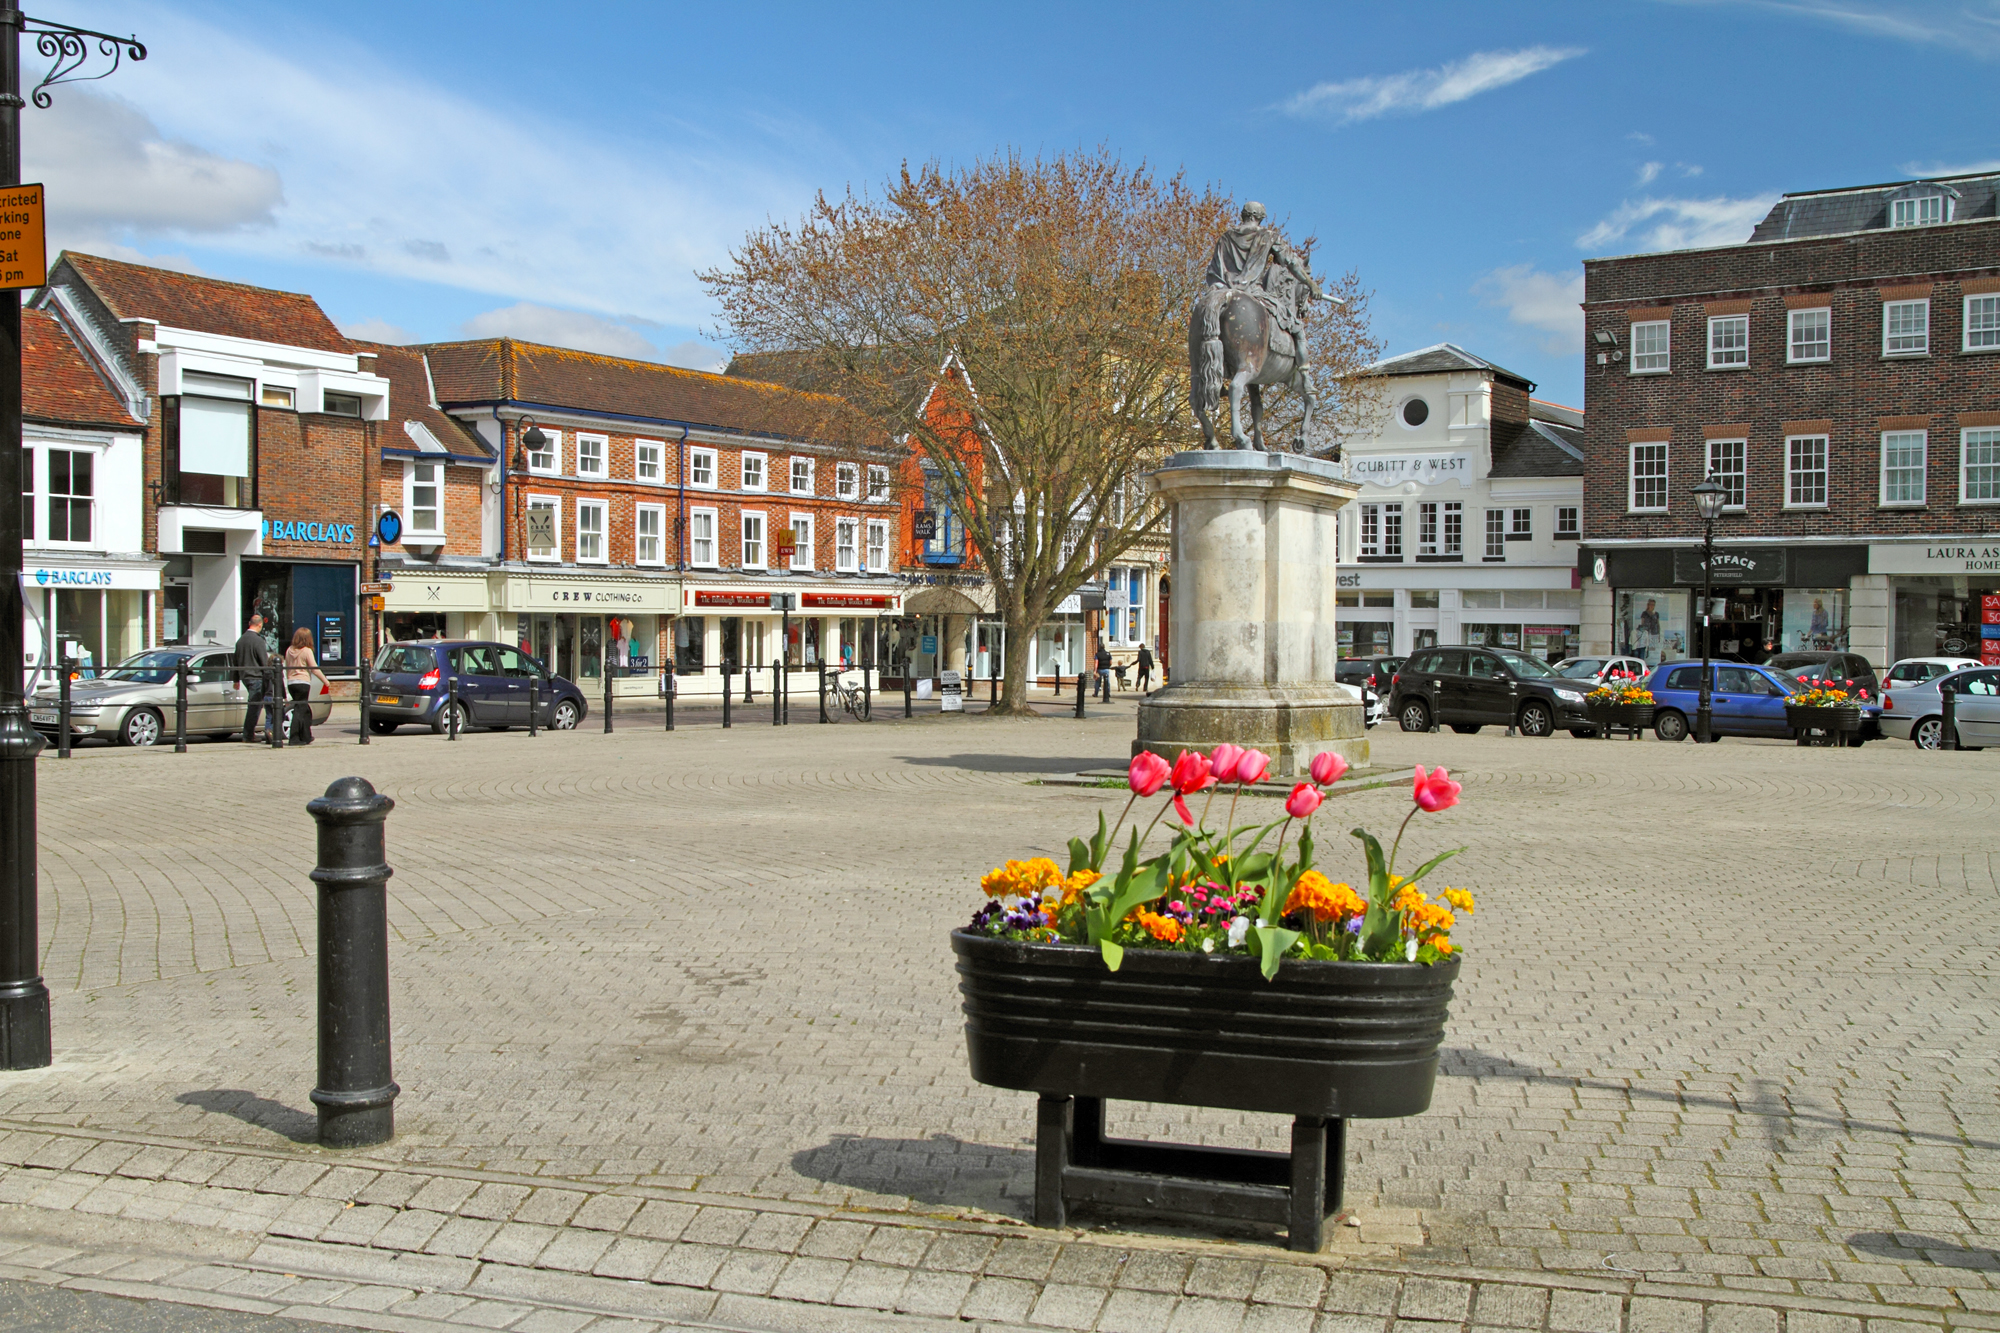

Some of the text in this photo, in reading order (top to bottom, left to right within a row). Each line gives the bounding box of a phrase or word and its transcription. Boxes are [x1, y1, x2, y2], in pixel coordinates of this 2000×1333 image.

[1357, 458, 1466, 472] CUBITT & WEST
[273, 520, 355, 543] BARCLAYS
[1927, 548, 1976, 558] LAURA
[51, 571, 112, 585] BARCLAYS
[553, 592, 592, 601] CREW
[595, 593, 631, 602] CLOTHING
[701, 595, 765, 605] The Edinburgh Woollen Mill
[817, 597, 825, 605] The
[827, 597, 847, 606] Edinburgh
[630, 658, 635, 667] 3
[643, 658, 647, 667] 2
